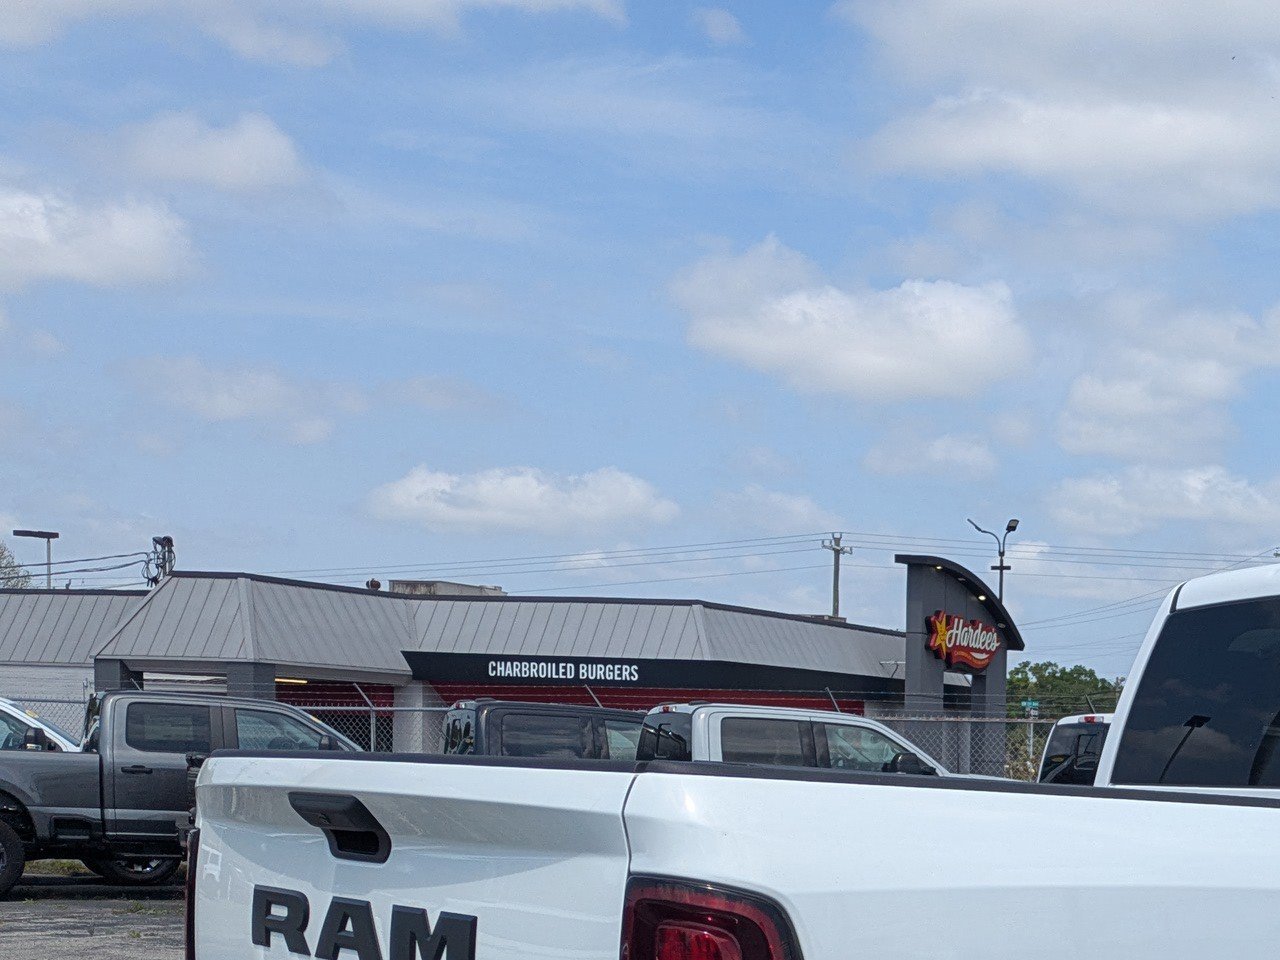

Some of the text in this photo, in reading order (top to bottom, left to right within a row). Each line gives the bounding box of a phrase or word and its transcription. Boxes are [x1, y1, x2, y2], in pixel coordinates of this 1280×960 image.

[945, 617, 1001, 652] Hardee's
[488, 660, 639, 681] CHARBROILED BURGERS
